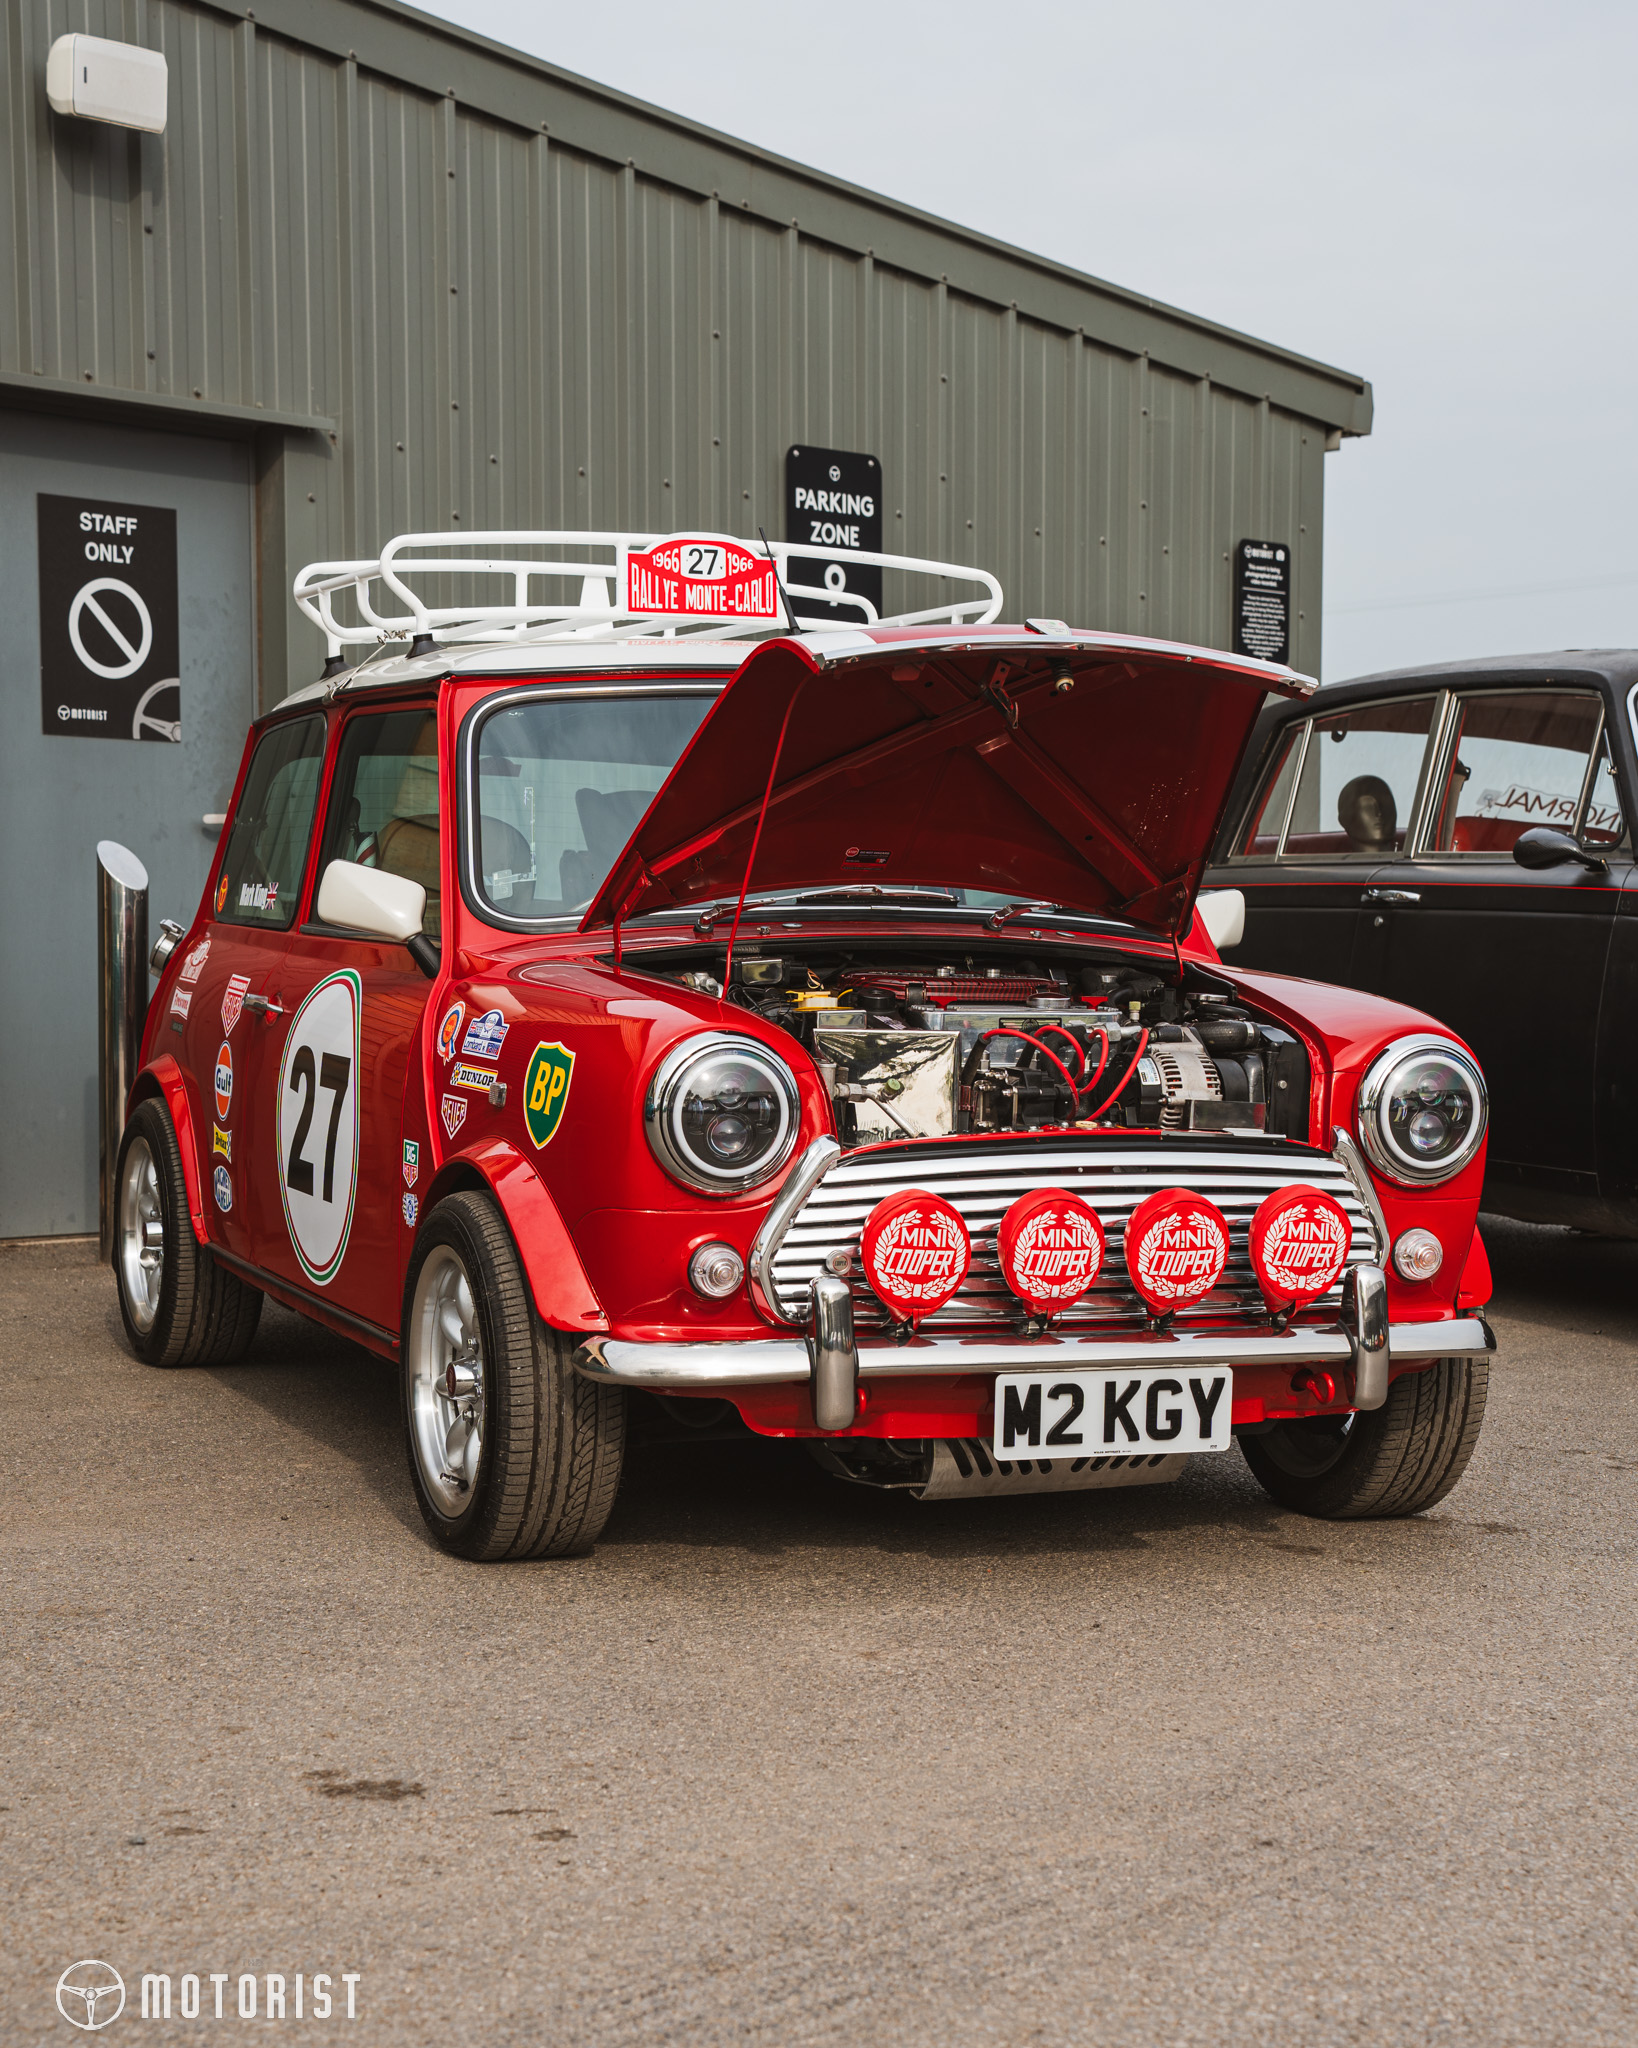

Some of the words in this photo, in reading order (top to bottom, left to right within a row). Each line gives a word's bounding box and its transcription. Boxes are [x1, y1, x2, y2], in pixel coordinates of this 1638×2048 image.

[795, 487, 875, 518] PARKING
[79, 511, 138, 536] STAFF
[810, 521, 860, 547] ZONE
[84, 541, 134, 565] ONLY
[652, 548, 680, 573] 1966
[688, 548, 718, 575] 27
[727, 552, 753, 576] 1966
[631, 562, 679, 610] RALLYE
[685, 571, 773, 614] MONTE-CARLO
[71, 708, 108, 721] MOTORIST
[215, 1068, 232, 1093] Gulf
[459, 1069, 494, 1086] DUNLOP
[528, 1060, 566, 1115] BP
[286, 1045, 351, 1203] 27
[443, 1098, 465, 1132] HEUER
[215, 1131, 228, 1150] Britax
[405, 1144, 416, 1164] TAG
[900, 1227, 947, 1247] MINI
[1037, 1228, 1082, 1248] MINI
[1162, 1229, 1207, 1249] MINI
[1287, 1221, 1330, 1241] MINI
[884, 1248, 955, 1276] COOPER
[1024, 1249, 1090, 1277] COOPER
[1149, 1248, 1215, 1276] COOPER
[1273, 1241, 1337, 1268] COOPER
[1002, 1382, 1084, 1448] M2
[1103, 1377, 1226, 1443] KGY
